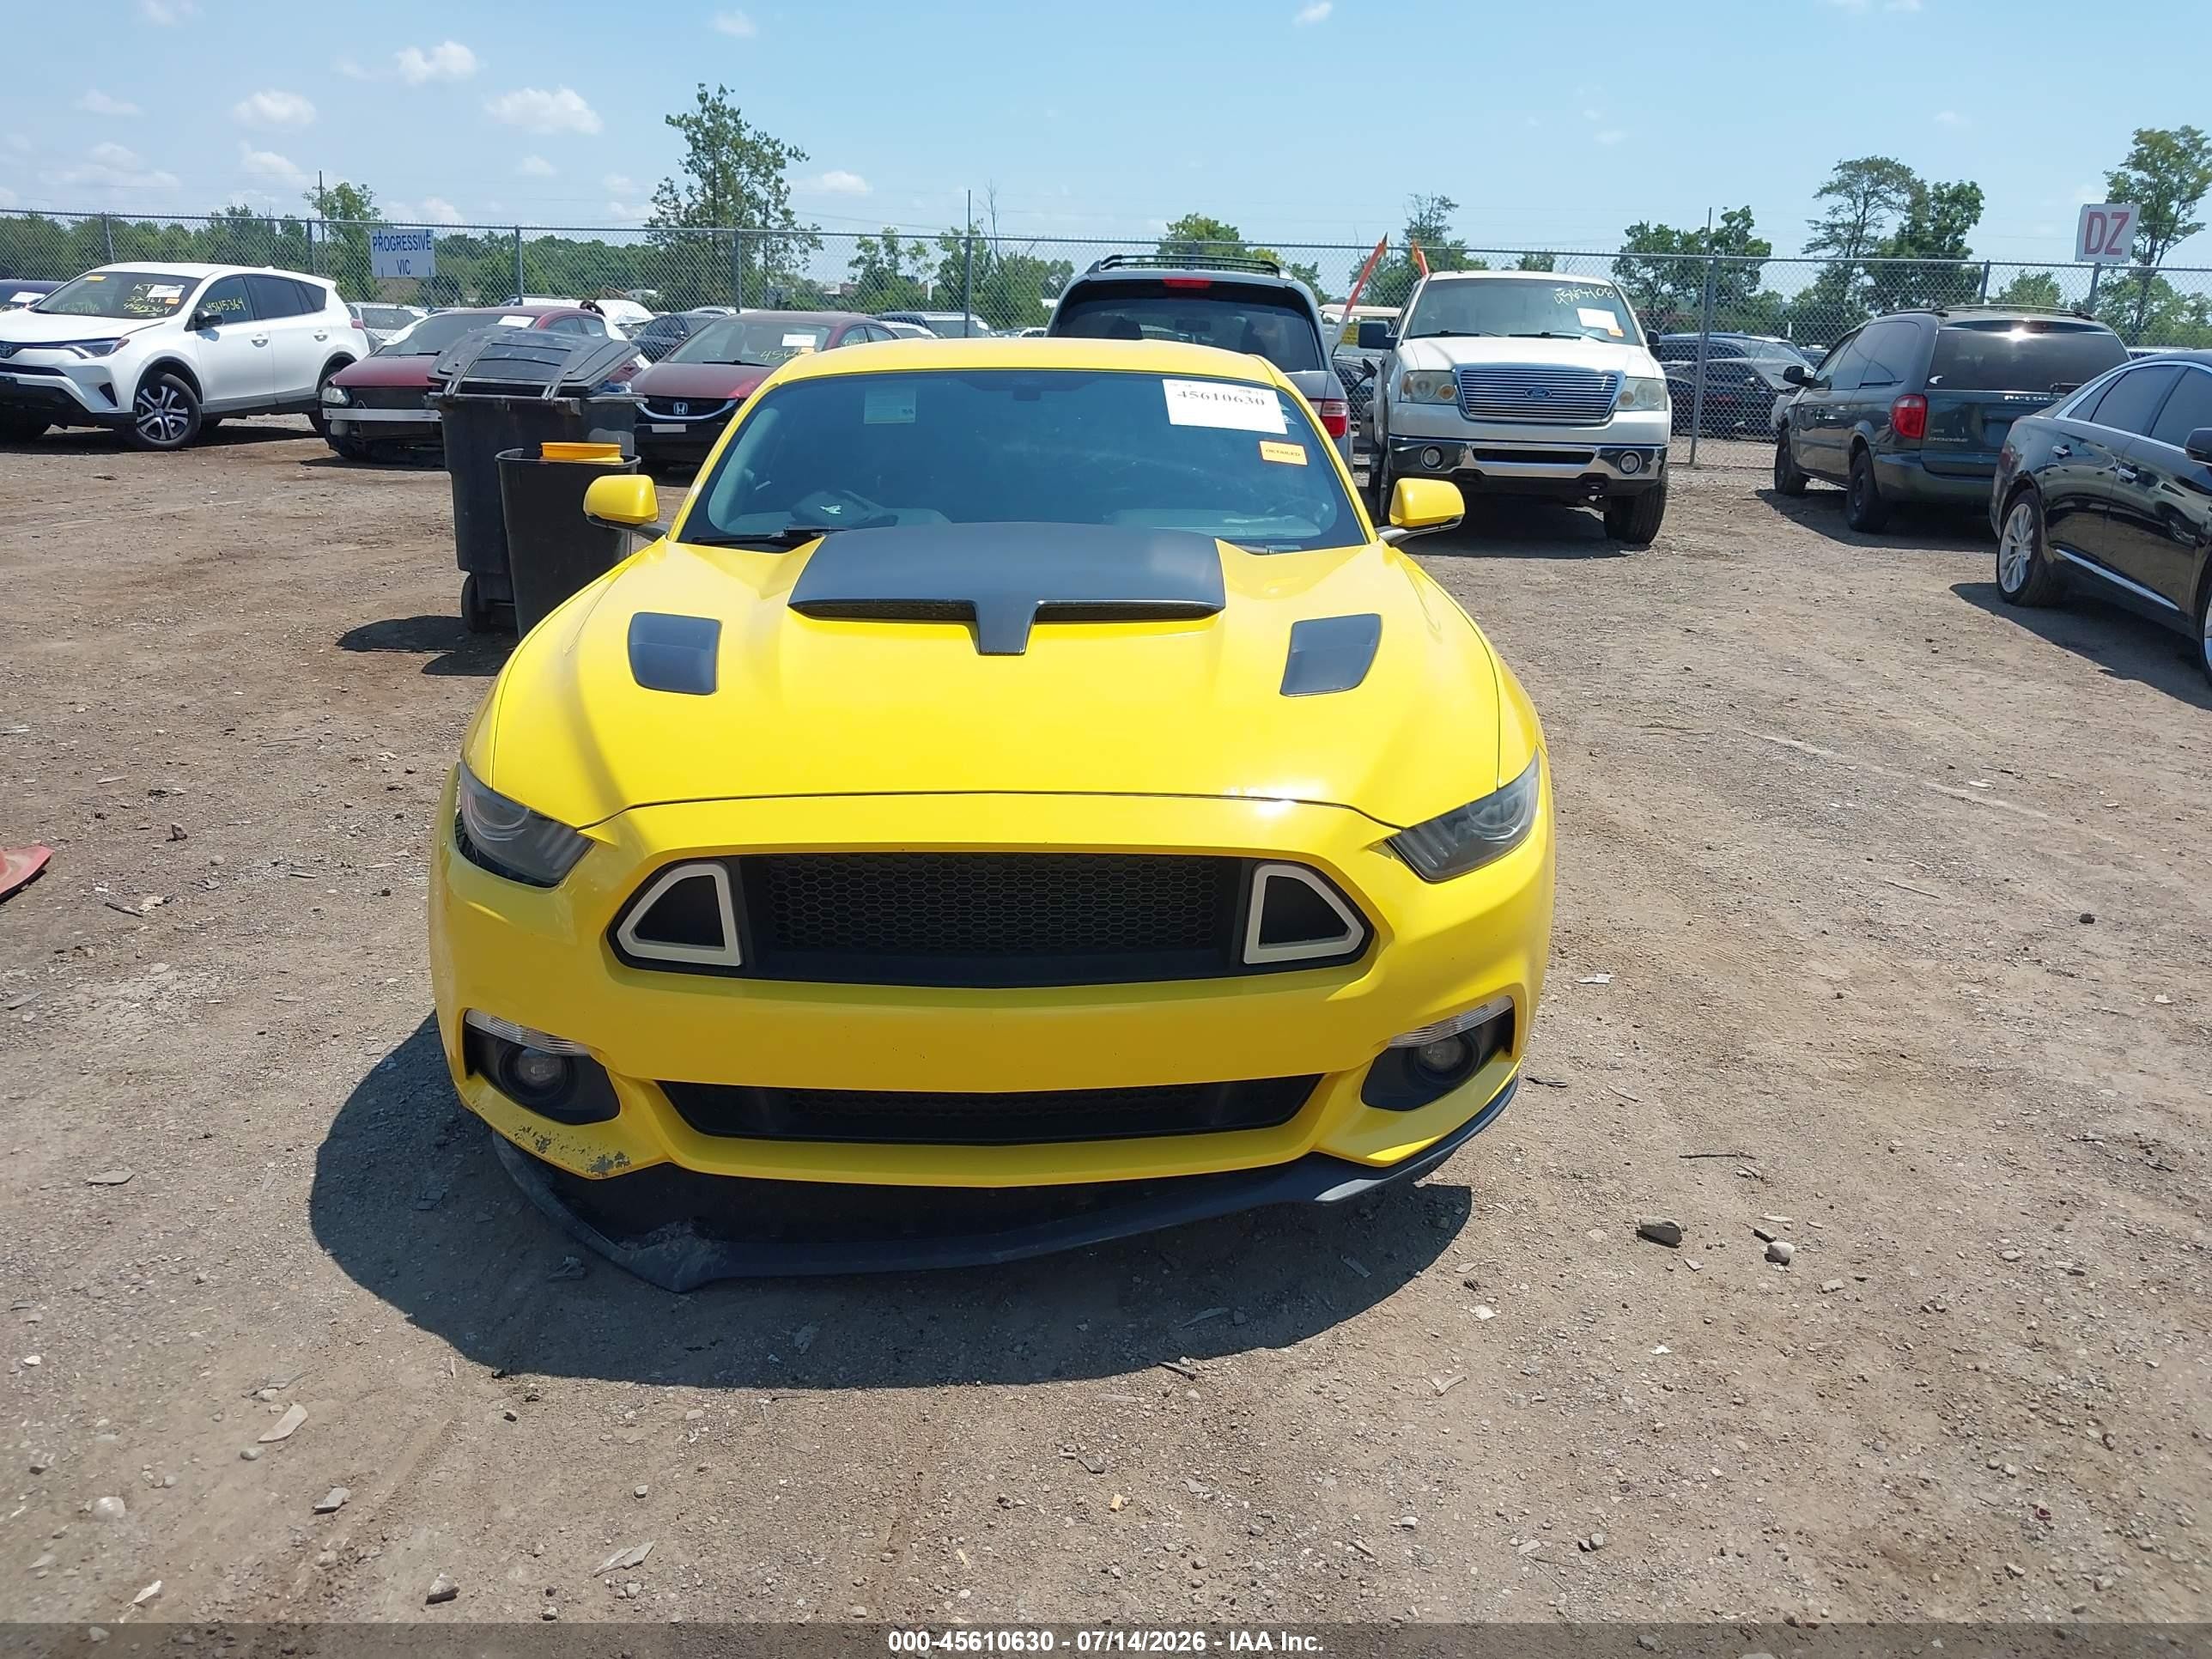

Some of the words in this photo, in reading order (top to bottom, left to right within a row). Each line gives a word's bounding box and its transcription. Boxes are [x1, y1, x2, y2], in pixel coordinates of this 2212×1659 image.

[2084, 211, 2130, 255] DZ
[372, 234, 432, 252] PROGRESSIVE
[397, 259, 411, 276] VIC
[1176, 390, 1266, 406] 45610630
